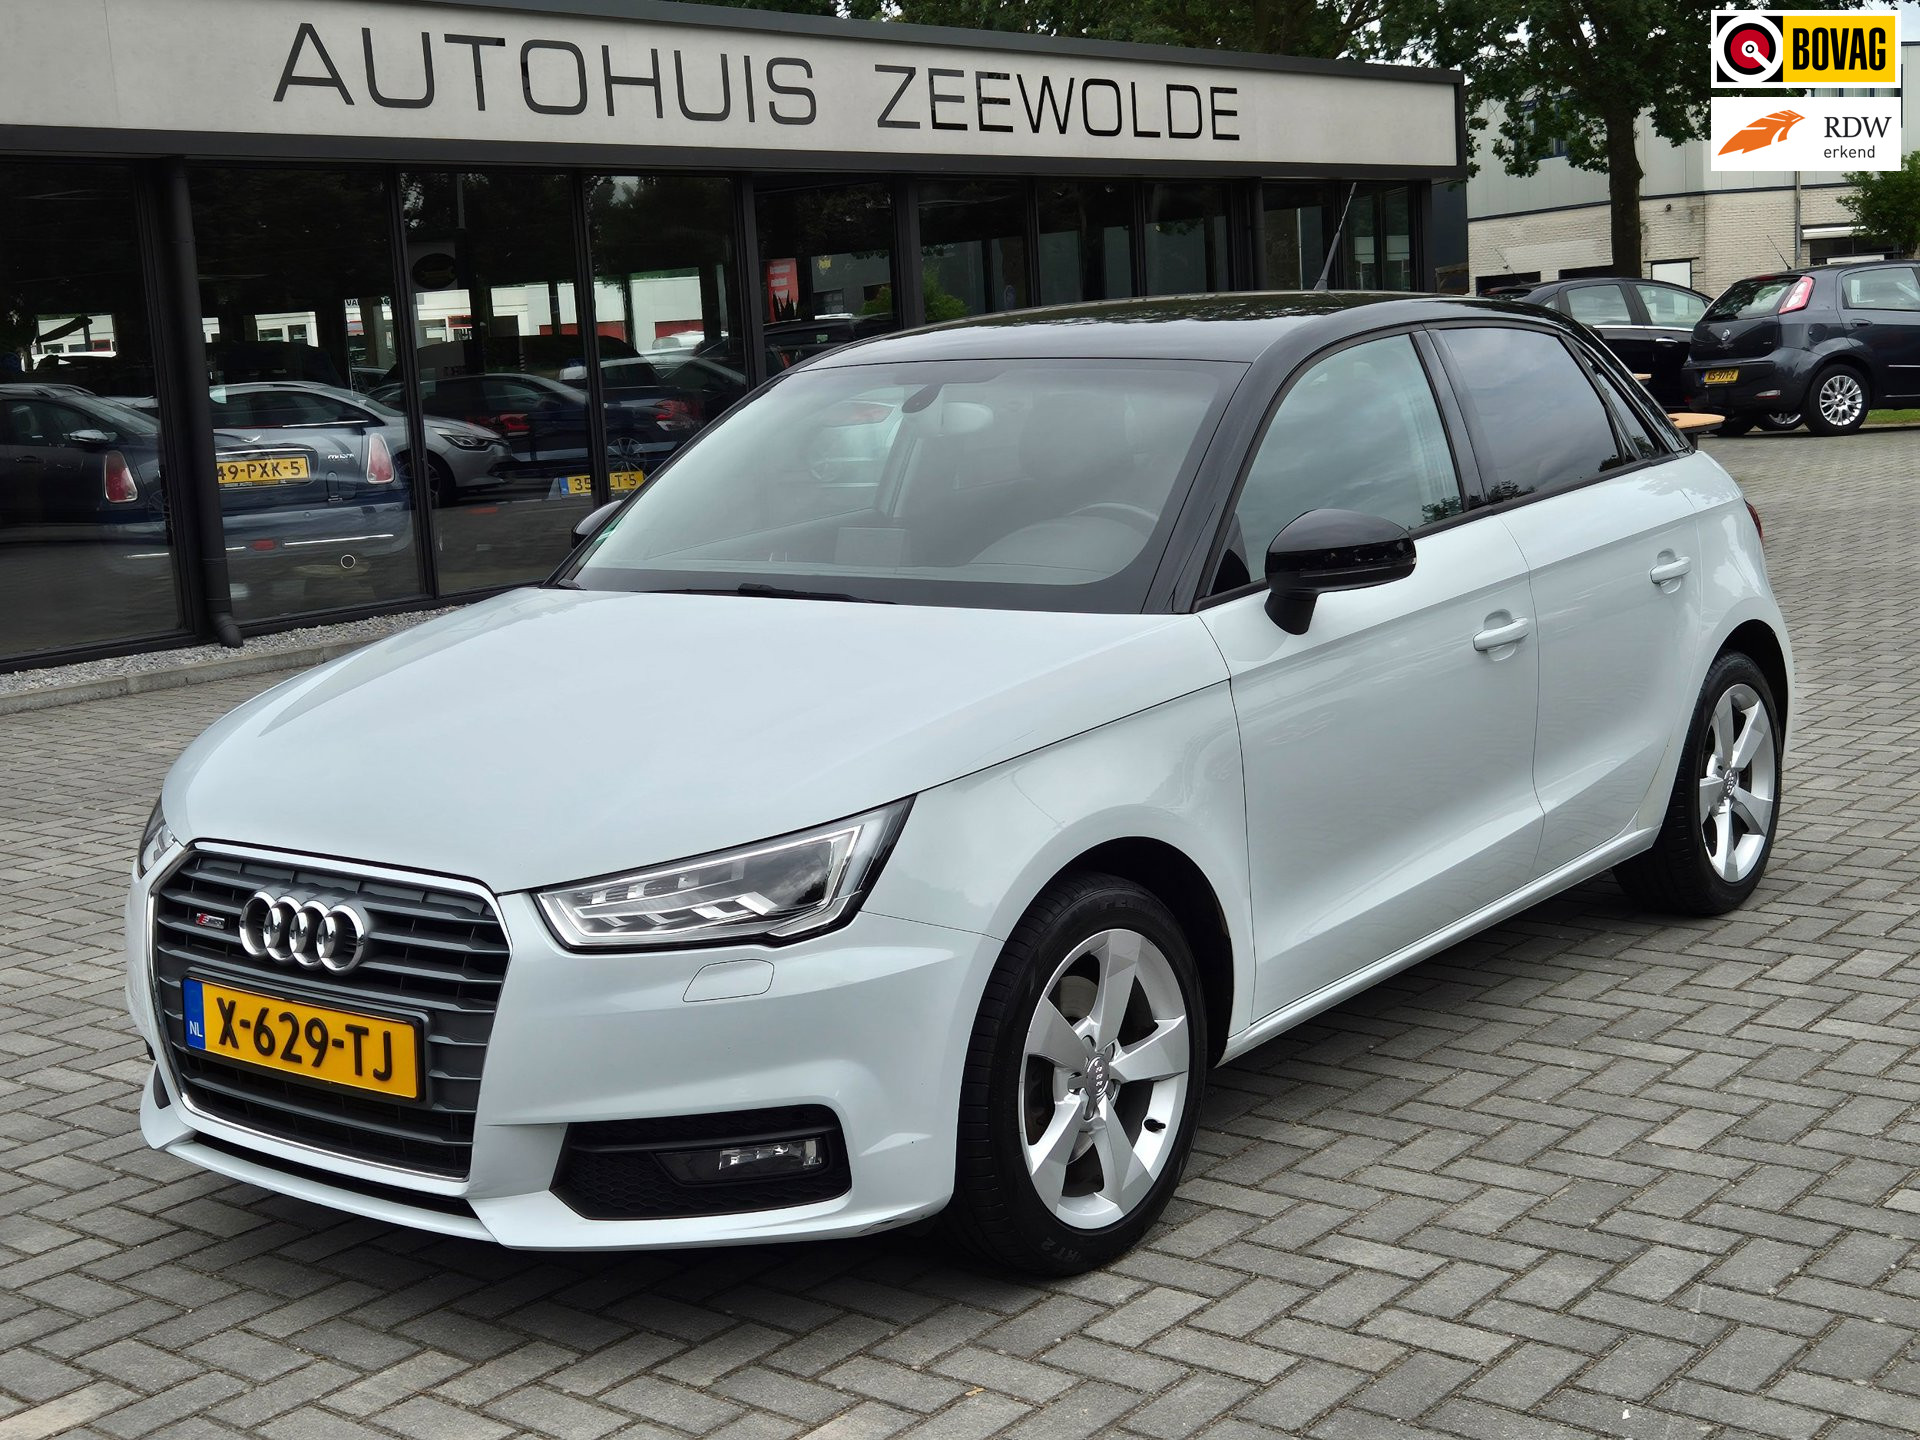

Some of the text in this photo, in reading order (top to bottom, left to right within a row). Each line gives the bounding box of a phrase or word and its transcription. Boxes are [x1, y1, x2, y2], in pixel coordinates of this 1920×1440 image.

[272, 22, 1240, 141] AUTOHUIS ZEEWOLDE
[217, 461, 301, 481] 49-PXK-5
[189, 997, 392, 1082] NL X-629-TJ
